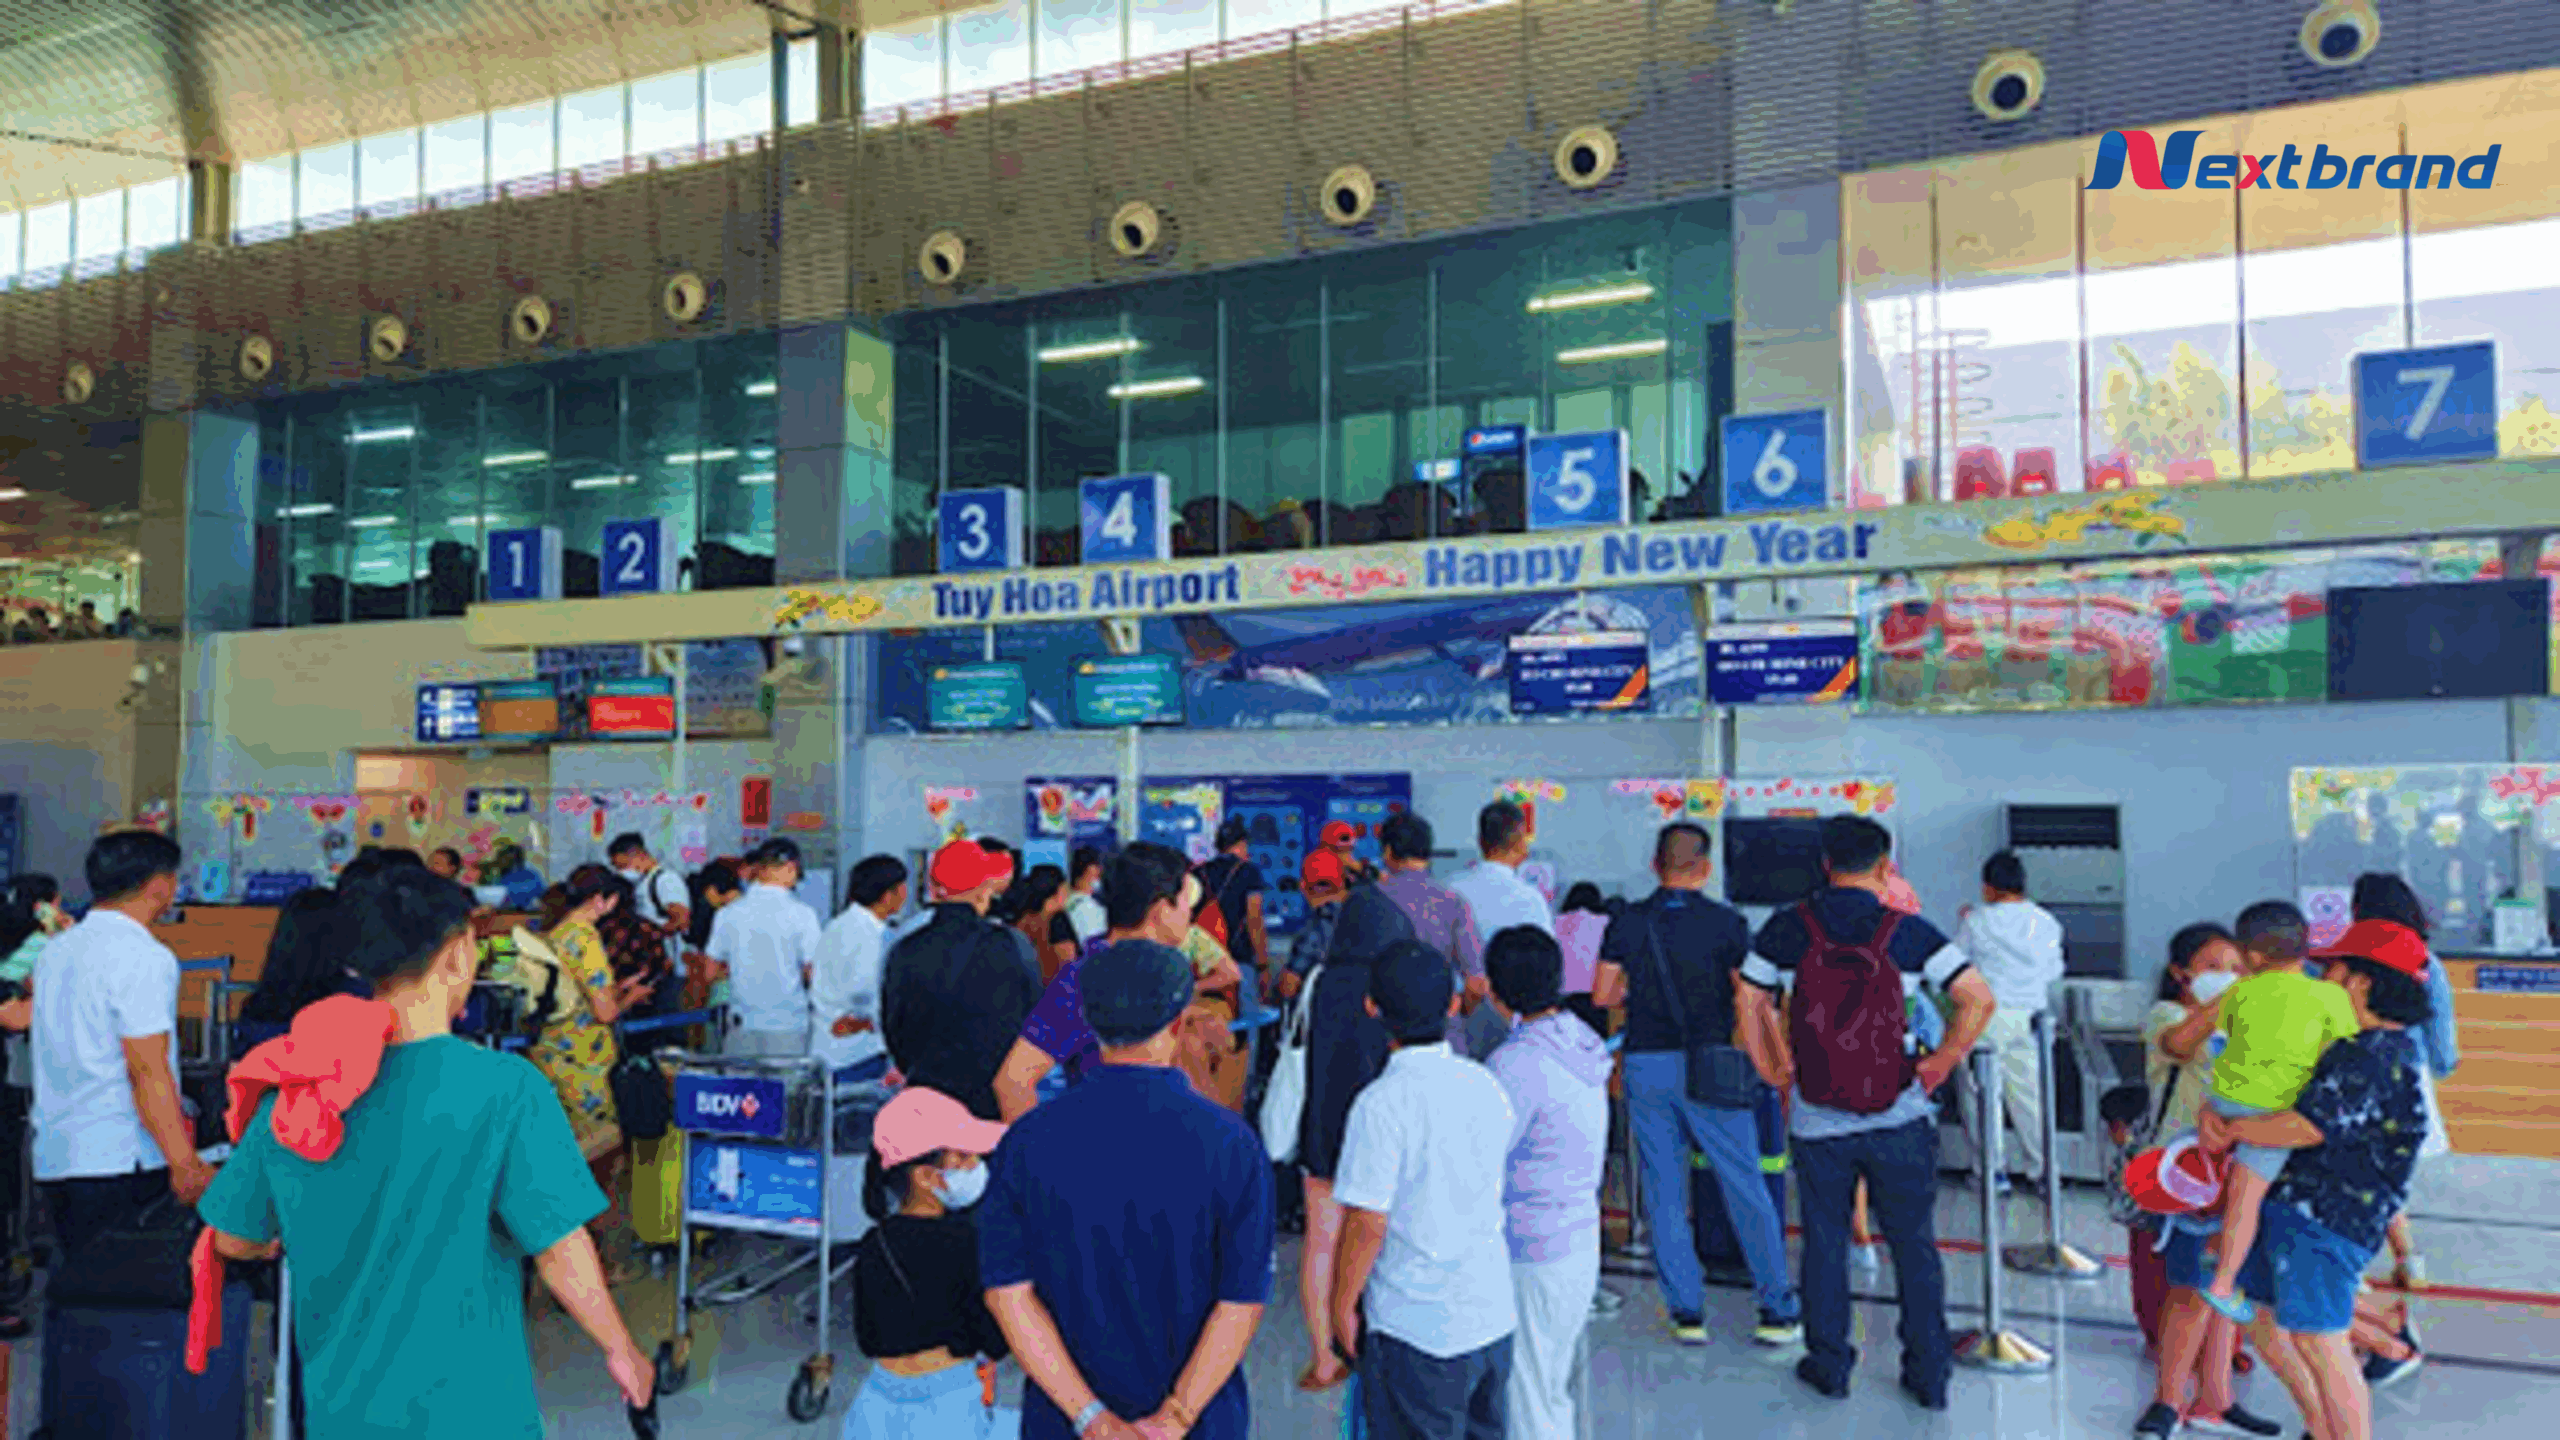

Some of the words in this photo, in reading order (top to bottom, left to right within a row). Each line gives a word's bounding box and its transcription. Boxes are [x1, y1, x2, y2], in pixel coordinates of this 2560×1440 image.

[2397, 364, 2455, 440] 7
[1552, 447, 1596, 514] 5
[1752, 429, 1798, 497] 6
[957, 503, 991, 559] 3
[1101, 491, 1138, 547] 4
[508, 540, 524, 588] 1
[617, 531, 646, 583] 2
[1425, 545, 1583, 587] Happy
[1602, 531, 1728, 576] New
[1749, 521, 1878, 565] Year
[931, 581, 996, 620] Tuy
[1002, 576, 1081, 614] Hoa
[1090, 562, 1240, 609] Airport
